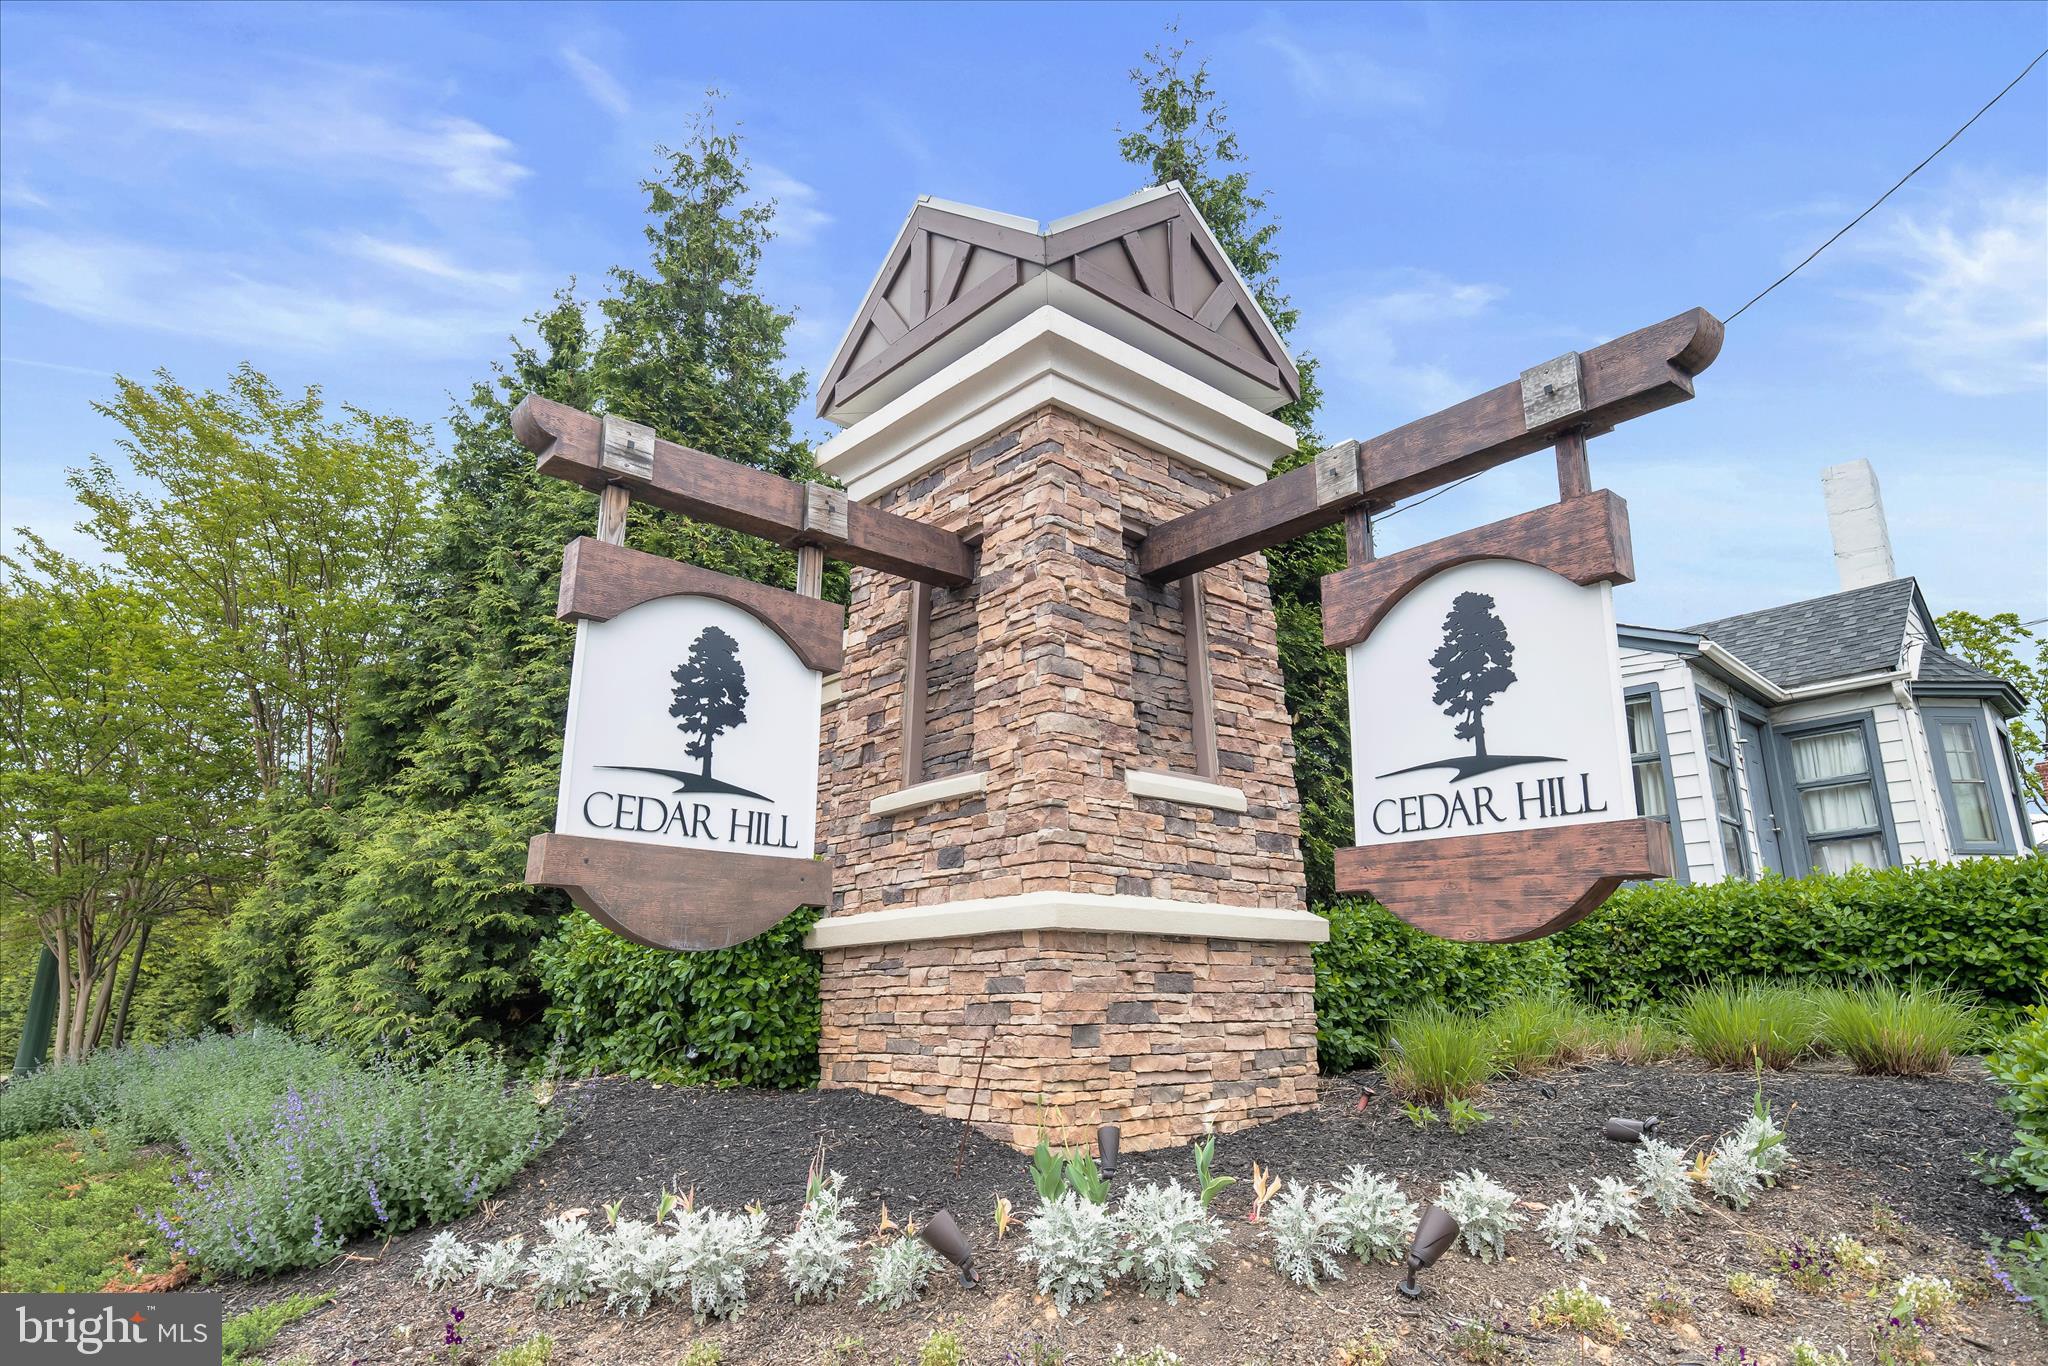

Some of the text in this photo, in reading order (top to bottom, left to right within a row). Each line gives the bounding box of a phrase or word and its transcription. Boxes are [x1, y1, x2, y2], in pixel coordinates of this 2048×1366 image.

[583, 791, 799, 849] CEDAR HILL
[1373, 773, 1608, 835] CEDAR HILL
